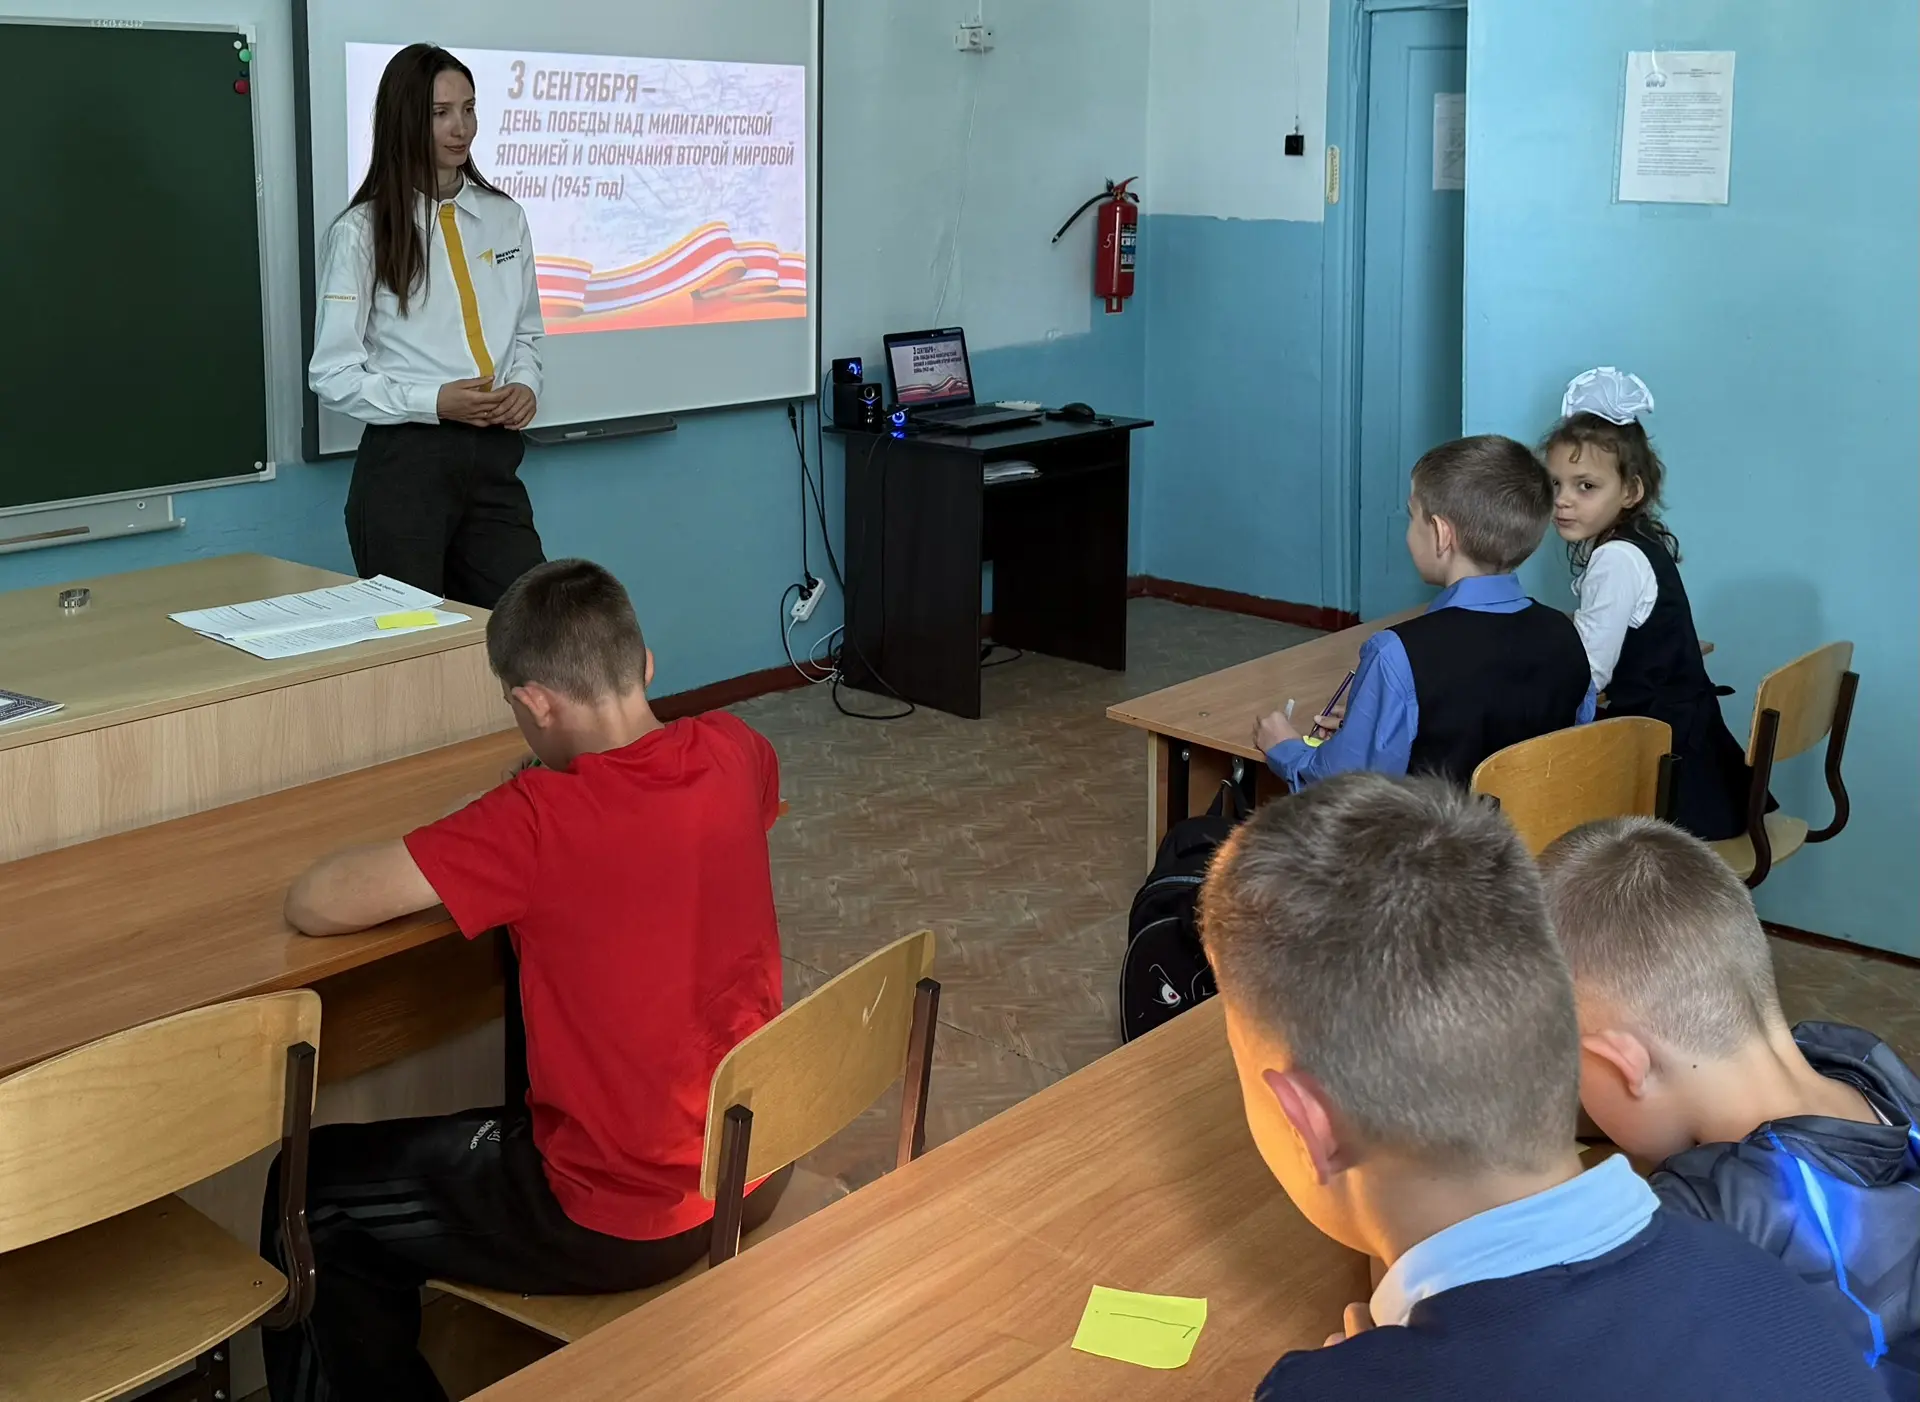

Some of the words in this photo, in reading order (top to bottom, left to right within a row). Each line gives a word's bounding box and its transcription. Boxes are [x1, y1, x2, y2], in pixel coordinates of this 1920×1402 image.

[508, 60, 525, 99] 3
[533, 70, 638, 103] СЕНТЯБРЯ
[499, 109, 542, 136] ДЕНЬ
[546, 110, 611, 137] ПОБЕДЫ
[613, 112, 644, 138] НАД
[647, 110, 773, 137] МИЛИТАРИСТСКОЙ
[495, 138, 569, 166] ЯПОНИЕЙ
[572, 144, 584, 166] И
[587, 144, 674, 167] ОКОНЧАНИЯ
[676, 140, 729, 167] ВТОРОЙ
[731, 141, 795, 167] МИРОВОЙ
[552, 174, 591, 201] (1945
[595, 174, 624, 201] год)
